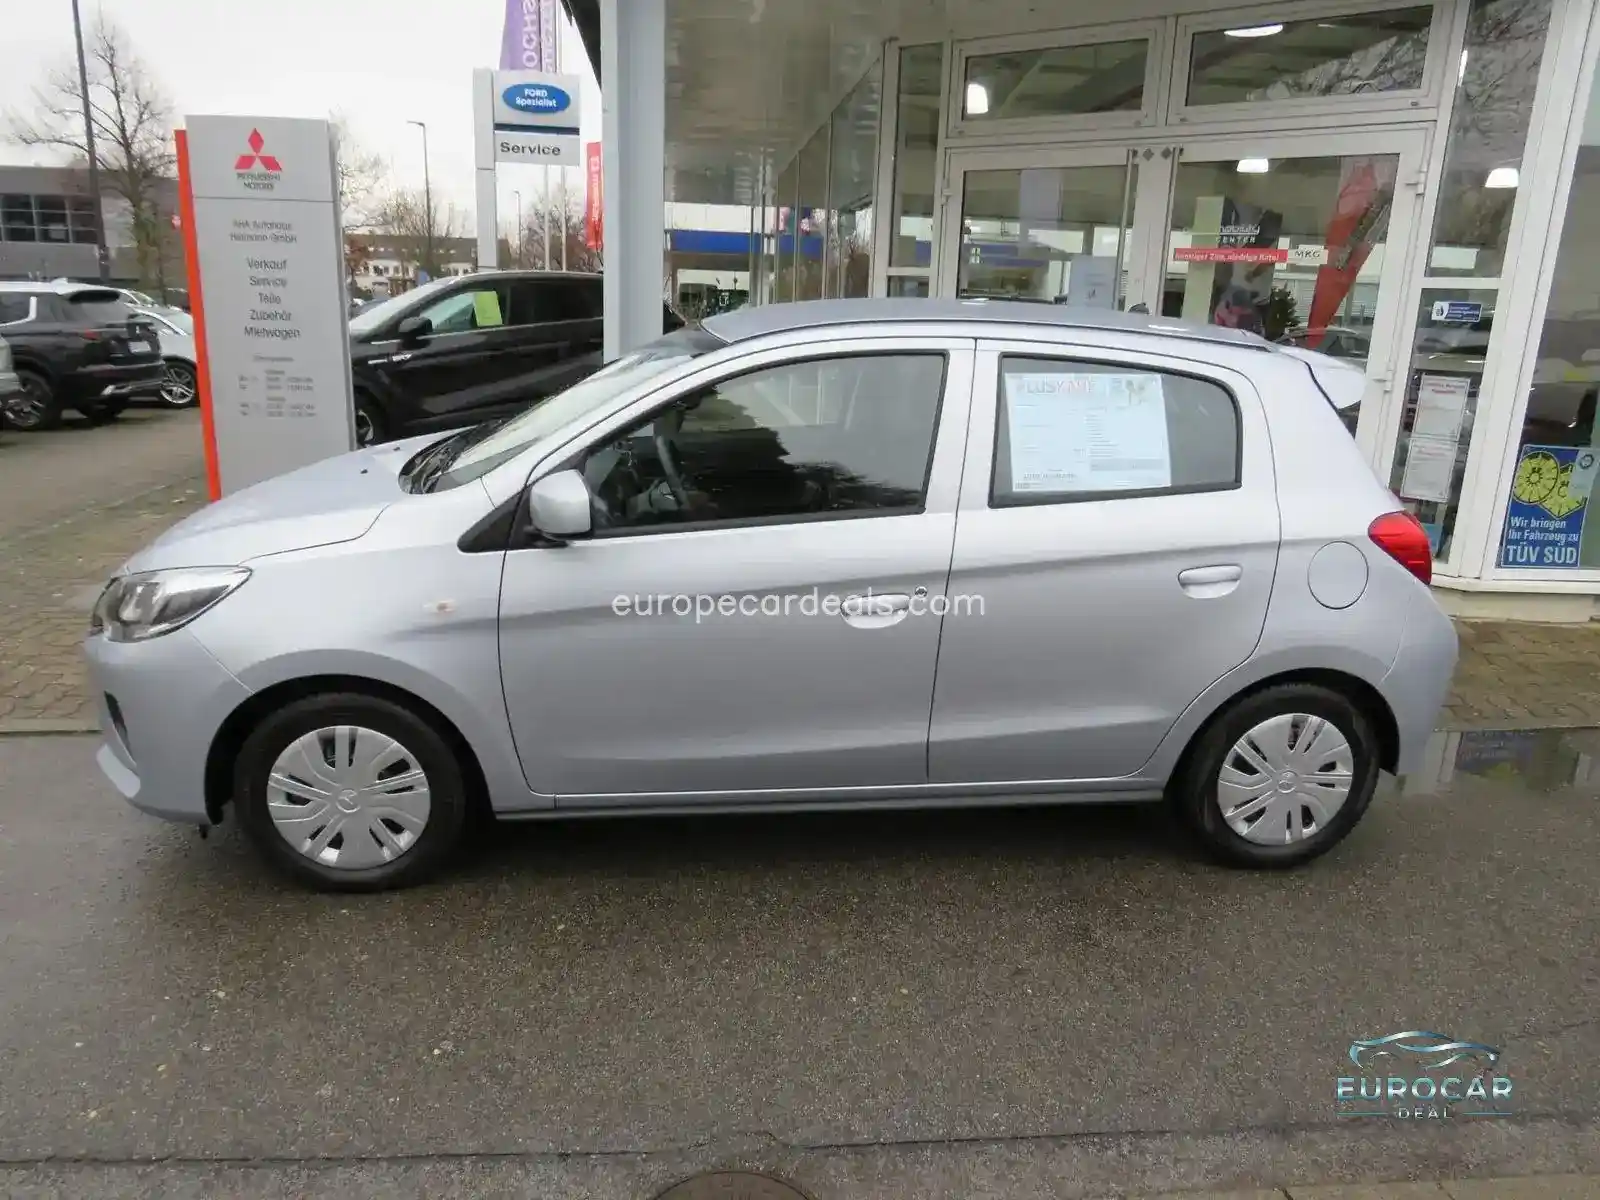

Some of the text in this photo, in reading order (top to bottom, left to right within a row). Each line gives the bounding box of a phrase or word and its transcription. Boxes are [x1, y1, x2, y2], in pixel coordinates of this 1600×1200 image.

[524, 87, 548, 97] FORD
[515, 96, 557, 108] Spezialist
[500, 141, 561, 156] Service
[246, 257, 287, 270] Verkauf
[249, 275, 287, 288] Service
[258, 292, 282, 305] Teile
[249, 309, 292, 322] Zubehör
[244, 326, 301, 340] Mietwagen
[1510, 516, 1566, 530] Wir bringen
[1508, 529, 1579, 544] Ihr Fahrzeug zu
[1507, 541, 1577, 564] TÜV SÜD
